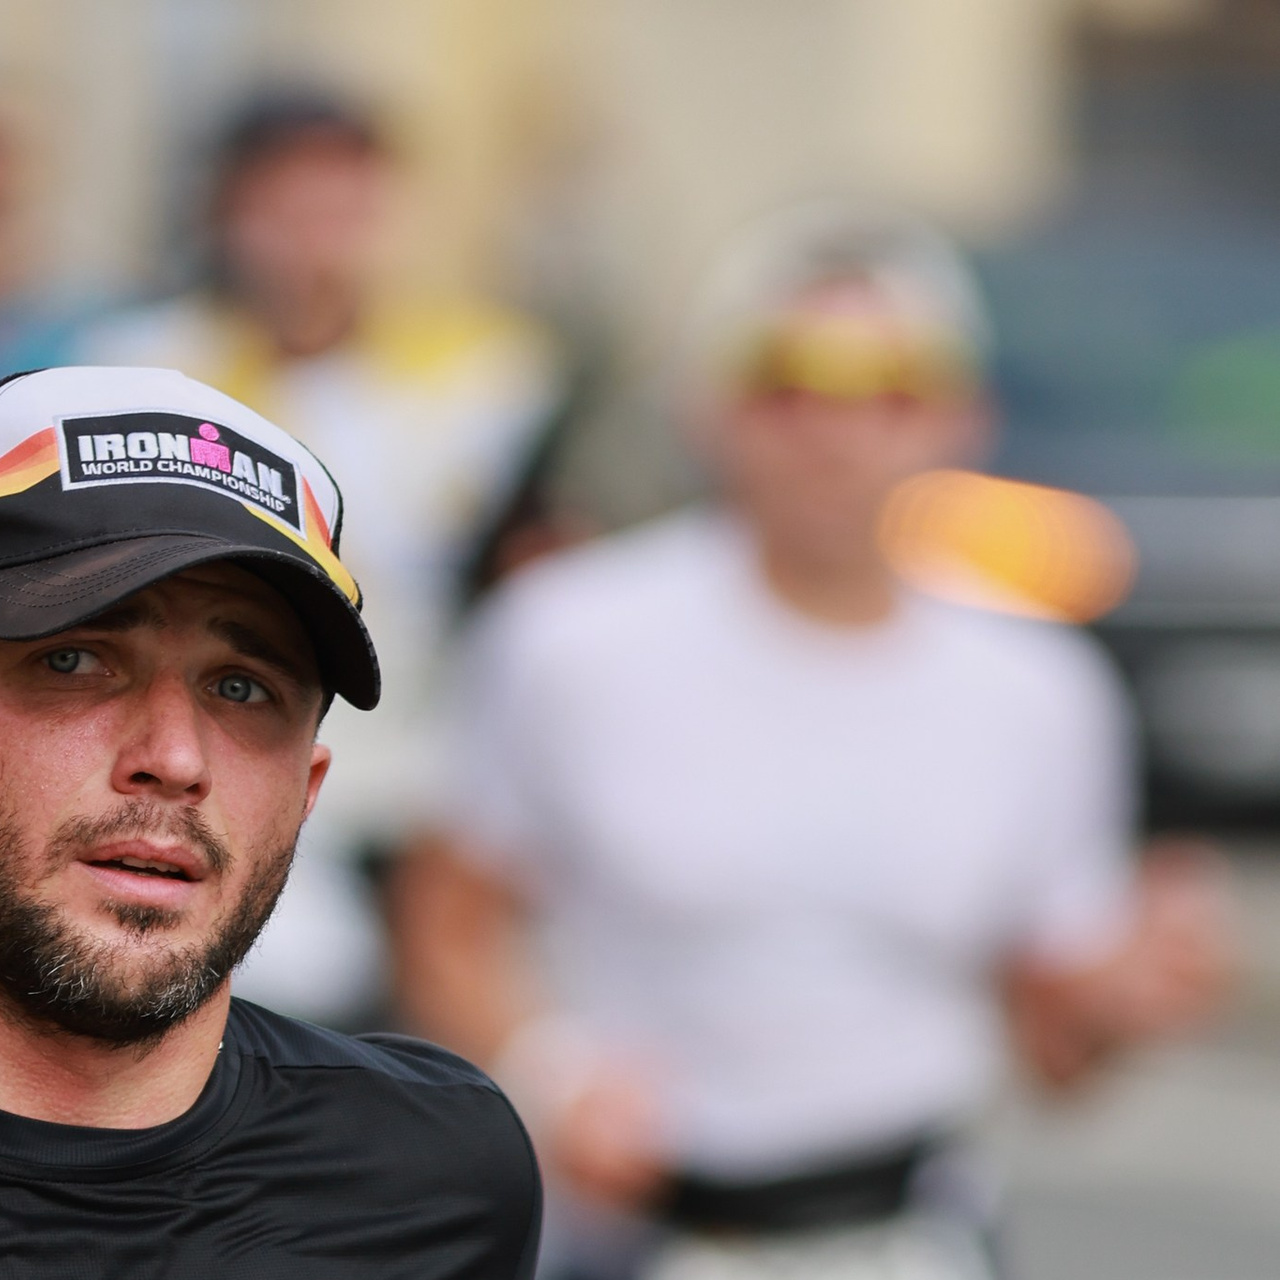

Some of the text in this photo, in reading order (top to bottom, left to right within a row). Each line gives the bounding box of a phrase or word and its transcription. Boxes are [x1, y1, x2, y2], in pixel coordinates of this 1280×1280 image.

[77, 423, 284, 500] IRONMAN
[81, 460, 286, 512] WORLD CHAMPIONSHIP
